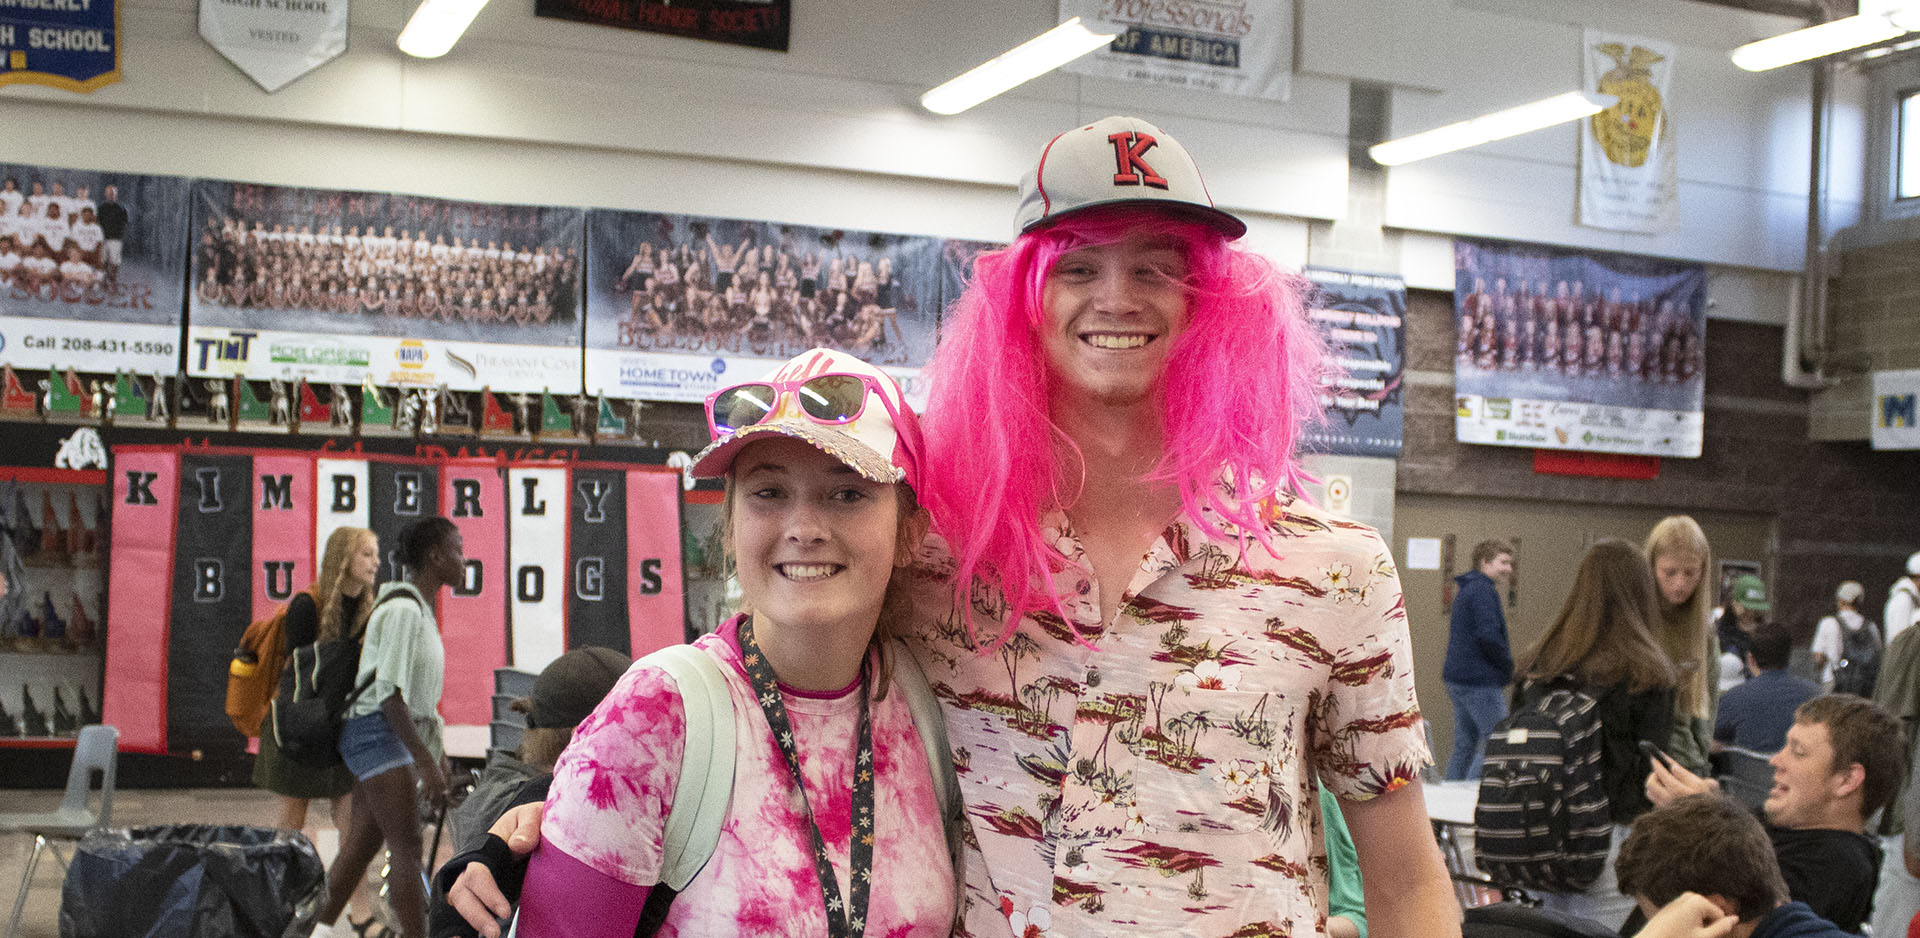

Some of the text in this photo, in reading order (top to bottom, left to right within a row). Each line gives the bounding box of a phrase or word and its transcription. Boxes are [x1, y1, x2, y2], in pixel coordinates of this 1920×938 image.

[1098, 0, 1252, 37] rofessionals
[28, 26, 110, 52] SCHOOL
[1150, 34, 1236, 62] AMERICA
[1108, 131, 1169, 190] K
[24, 335, 174, 356] Call 208-431-5590
[400, 348, 423, 362] NAPA
[125, 467, 611, 523] KIMBERLY
[194, 550, 662, 603] BUDOGS
